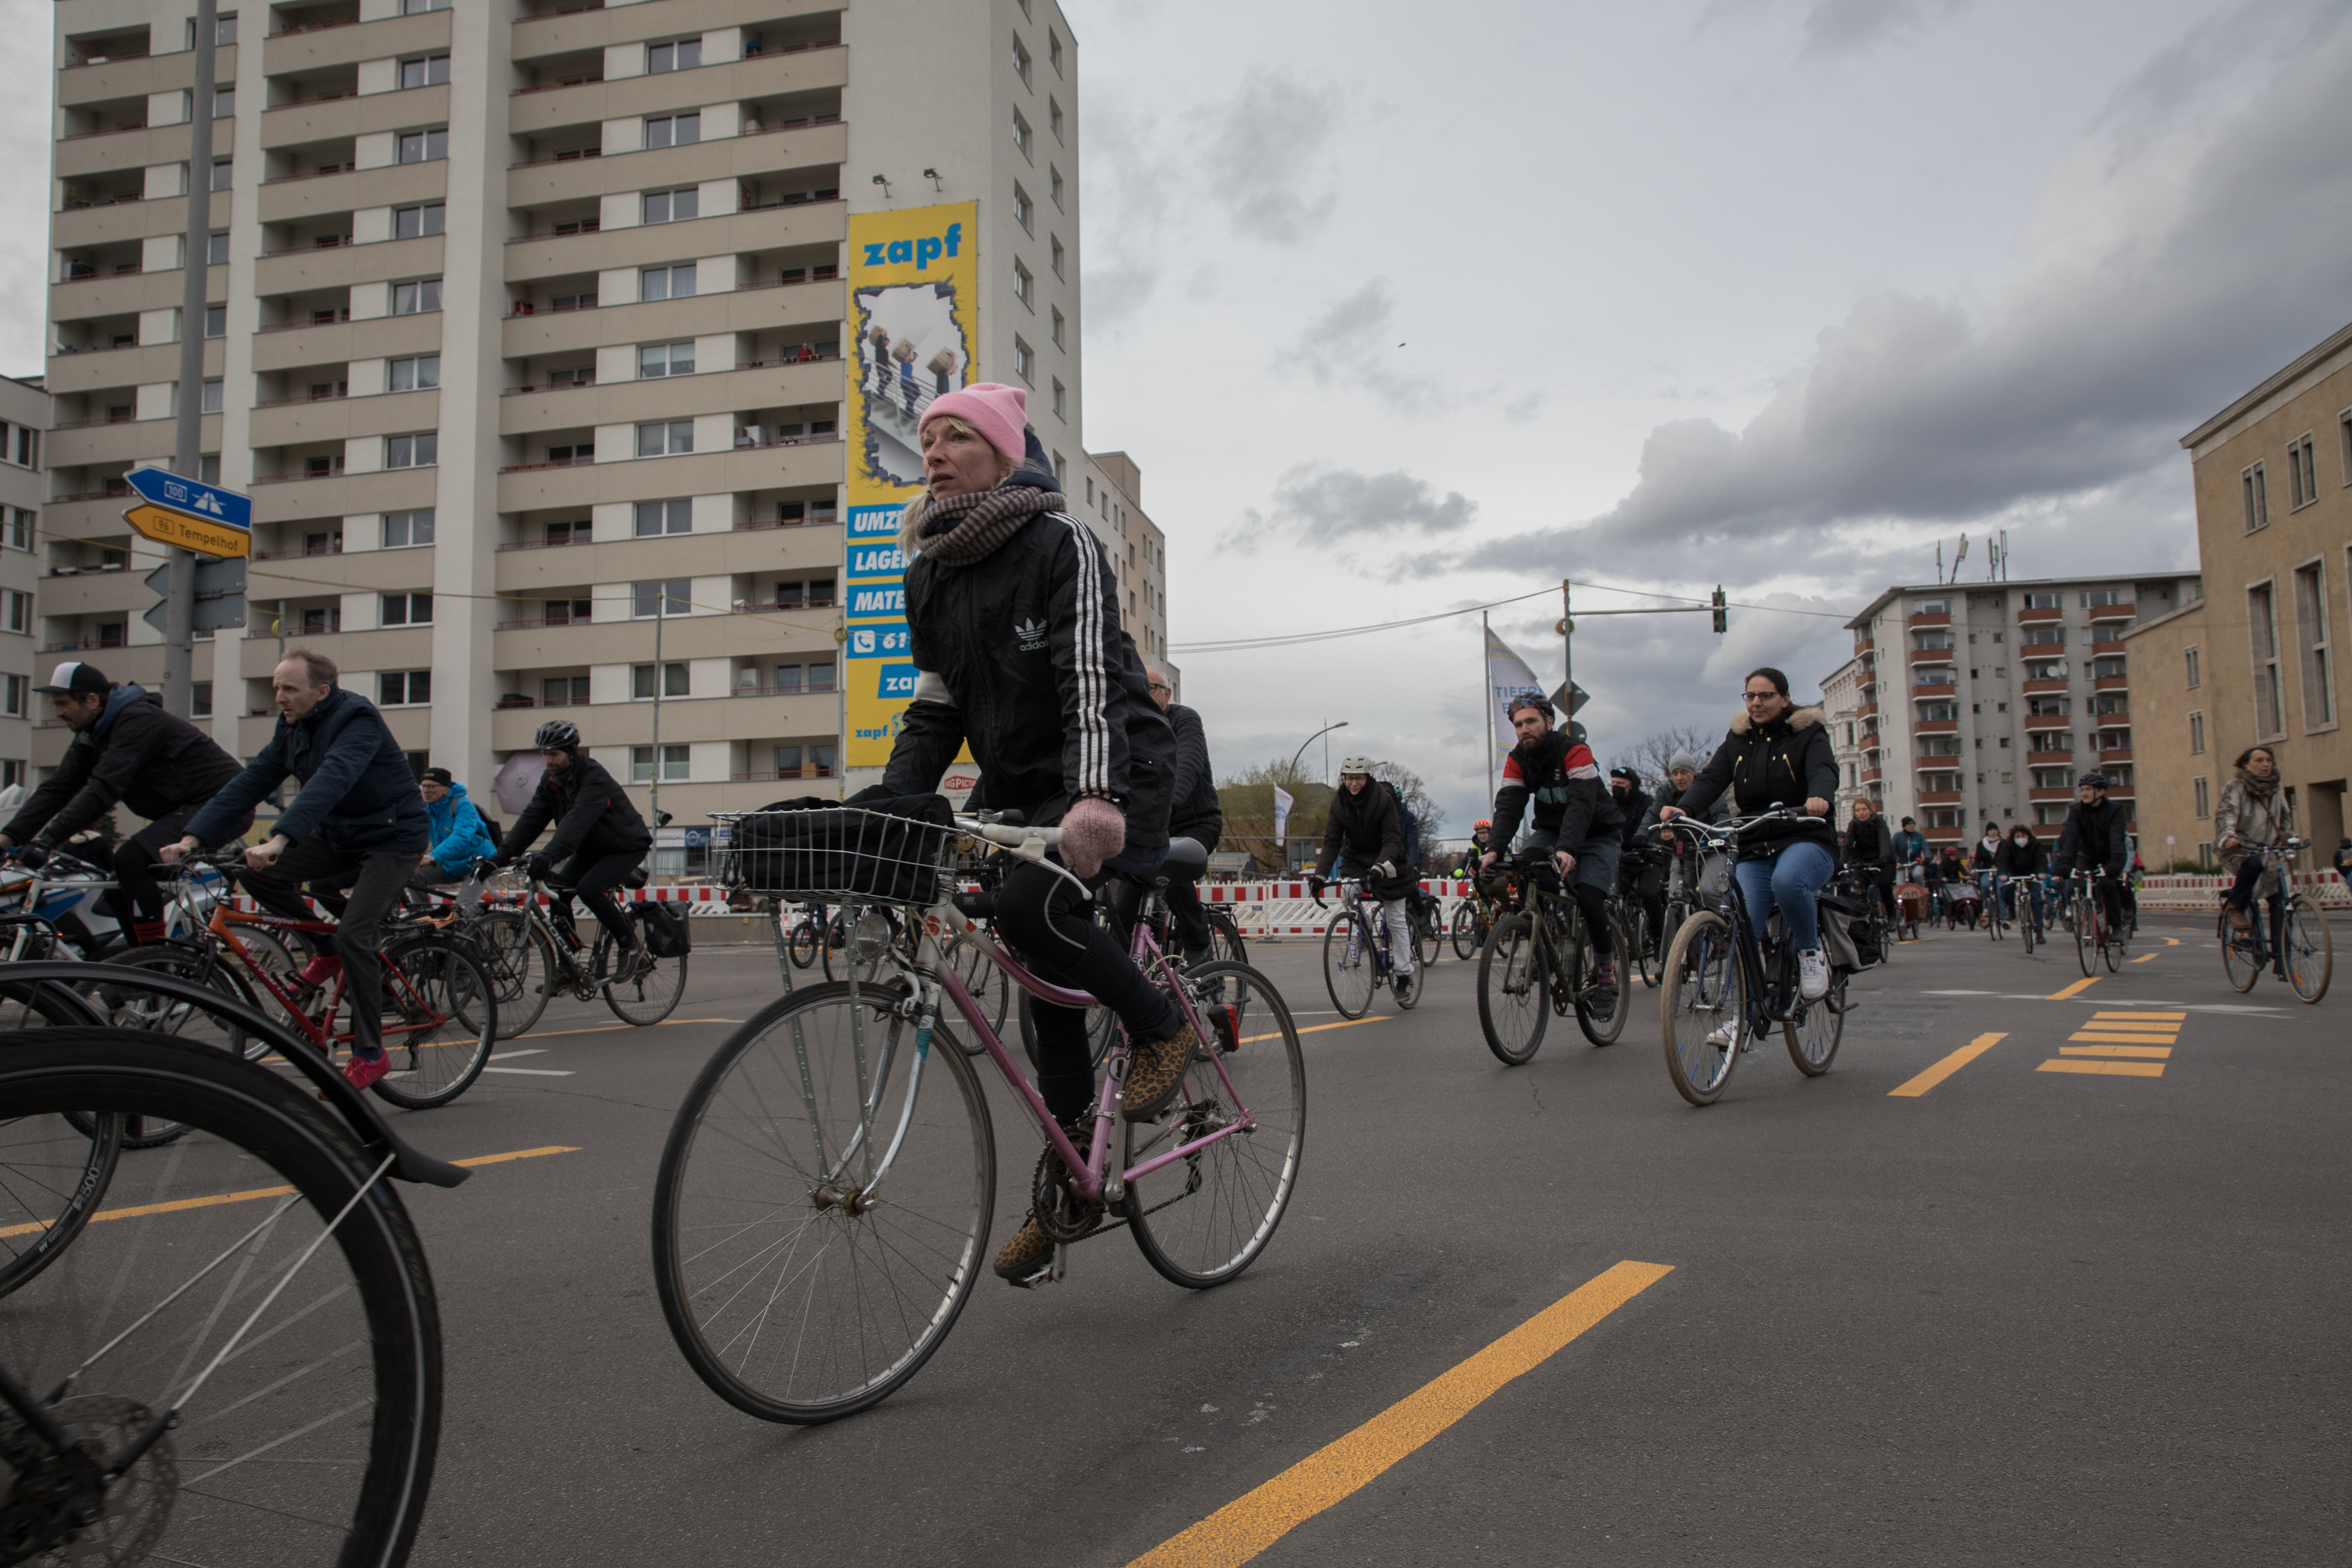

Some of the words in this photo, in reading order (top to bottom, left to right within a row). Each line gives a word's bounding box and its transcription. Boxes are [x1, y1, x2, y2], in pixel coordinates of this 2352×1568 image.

[863, 222, 962, 271] zapf
[168, 485, 184, 498] 100
[159, 520, 168, 530] 96
[178, 524, 237, 551] Tempelhof
[854, 589, 906, 611] MATE
[1019, 639, 1050, 652] adidas
[855, 724, 888, 740] zapf
[542, 917, 577, 964] FOCUS
